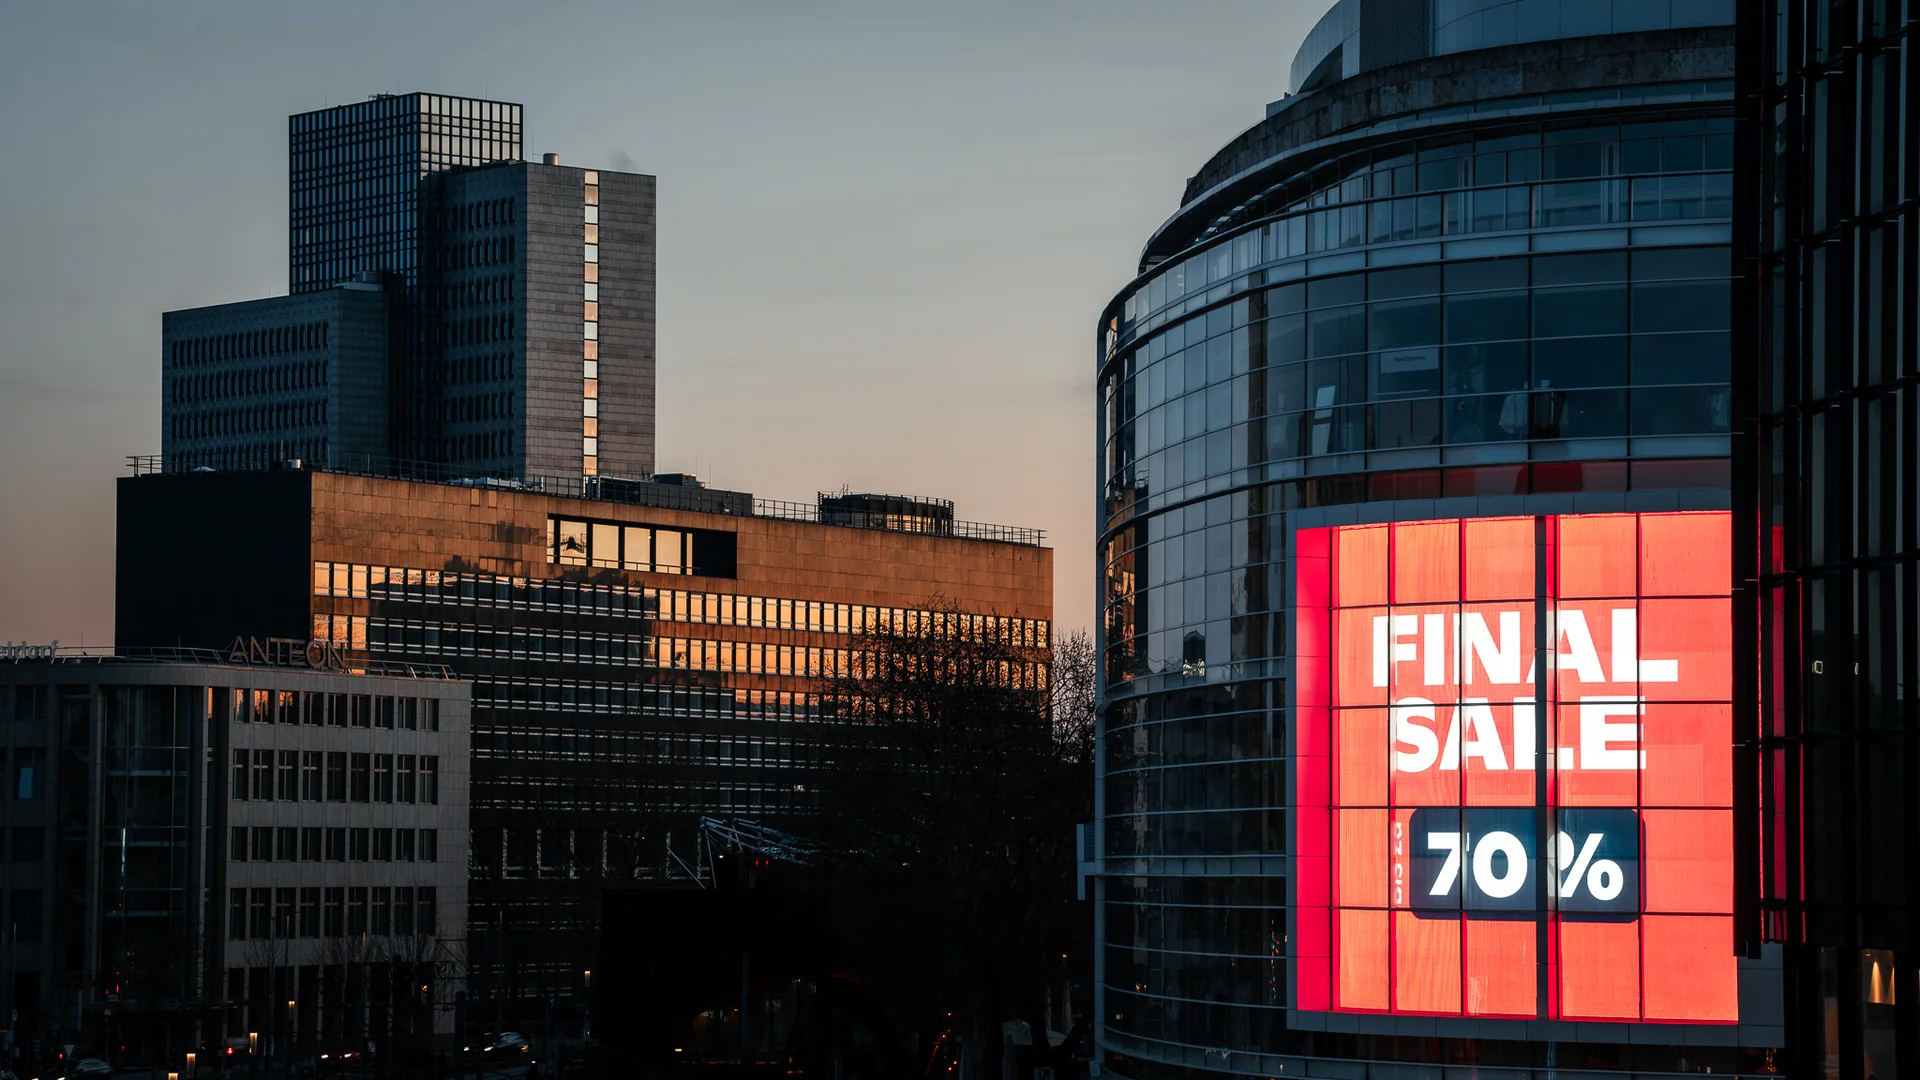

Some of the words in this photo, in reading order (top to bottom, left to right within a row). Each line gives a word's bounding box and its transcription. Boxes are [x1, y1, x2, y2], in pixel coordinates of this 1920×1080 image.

[229, 635, 346, 669] ANTEON
[1372, 608, 1678, 687] FINAL
[1391, 695, 1646, 773] SALE
